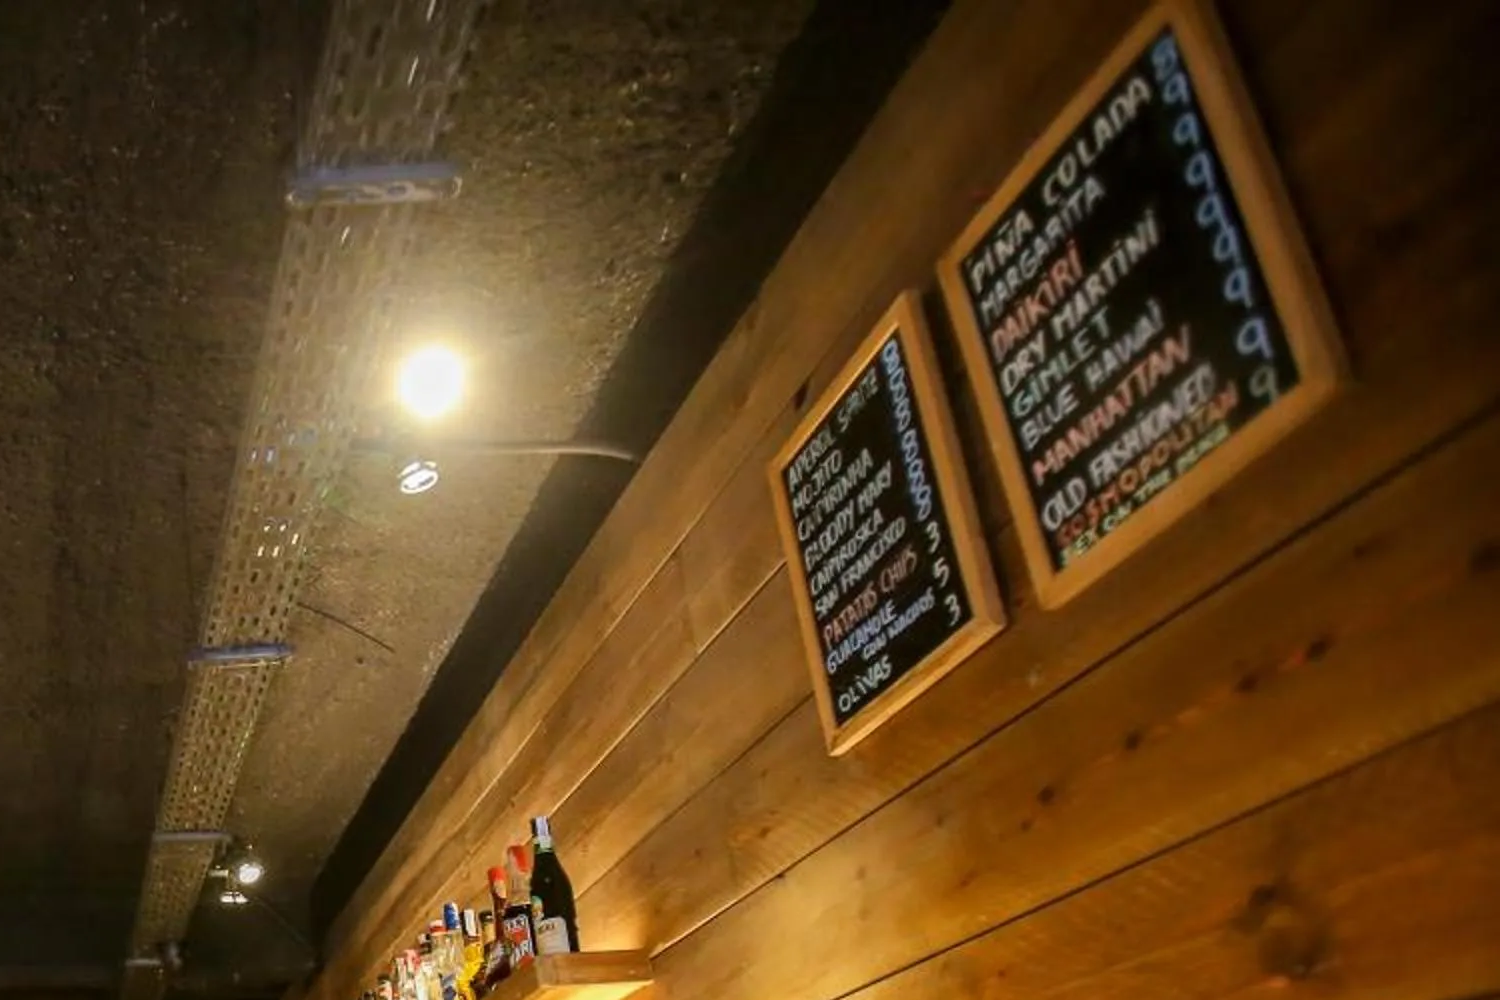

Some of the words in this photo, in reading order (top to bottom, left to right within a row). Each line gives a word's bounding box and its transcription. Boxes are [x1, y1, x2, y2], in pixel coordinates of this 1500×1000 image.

[1043, 78, 1150, 205] COLADA
[981, 178, 1102, 321] MARGARITA
[991, 247, 1081, 361] DAIKIRI
[1001, 331, 1045, 395] DRY
[1052, 208, 1158, 339] MARTINI
[1013, 309, 1108, 417] GIMLET
[1021, 384, 1078, 449] BLUE
[1033, 328, 1190, 485] MANHATTAN
[792, 449, 842, 518] MOJITO
[1042, 477, 1086, 530] OLD
[1089, 362, 1214, 487] FASHIONED
[1059, 382, 1238, 549] COSMOPOLITAN
[804, 500, 854, 572] BLOODY
[857, 461, 892, 514] MARY
[814, 584, 839, 620] SAN
[840, 517, 905, 593] FRANCISCO
[933, 557, 950, 587] 5
[823, 582, 877, 650] PATATAS
[880, 546, 917, 593] CHIPS
[926, 520, 941, 553] 3
[838, 655, 891, 712] OLIVAS
[944, 593, 961, 626] 3
[862, 633, 887, 660] CON
